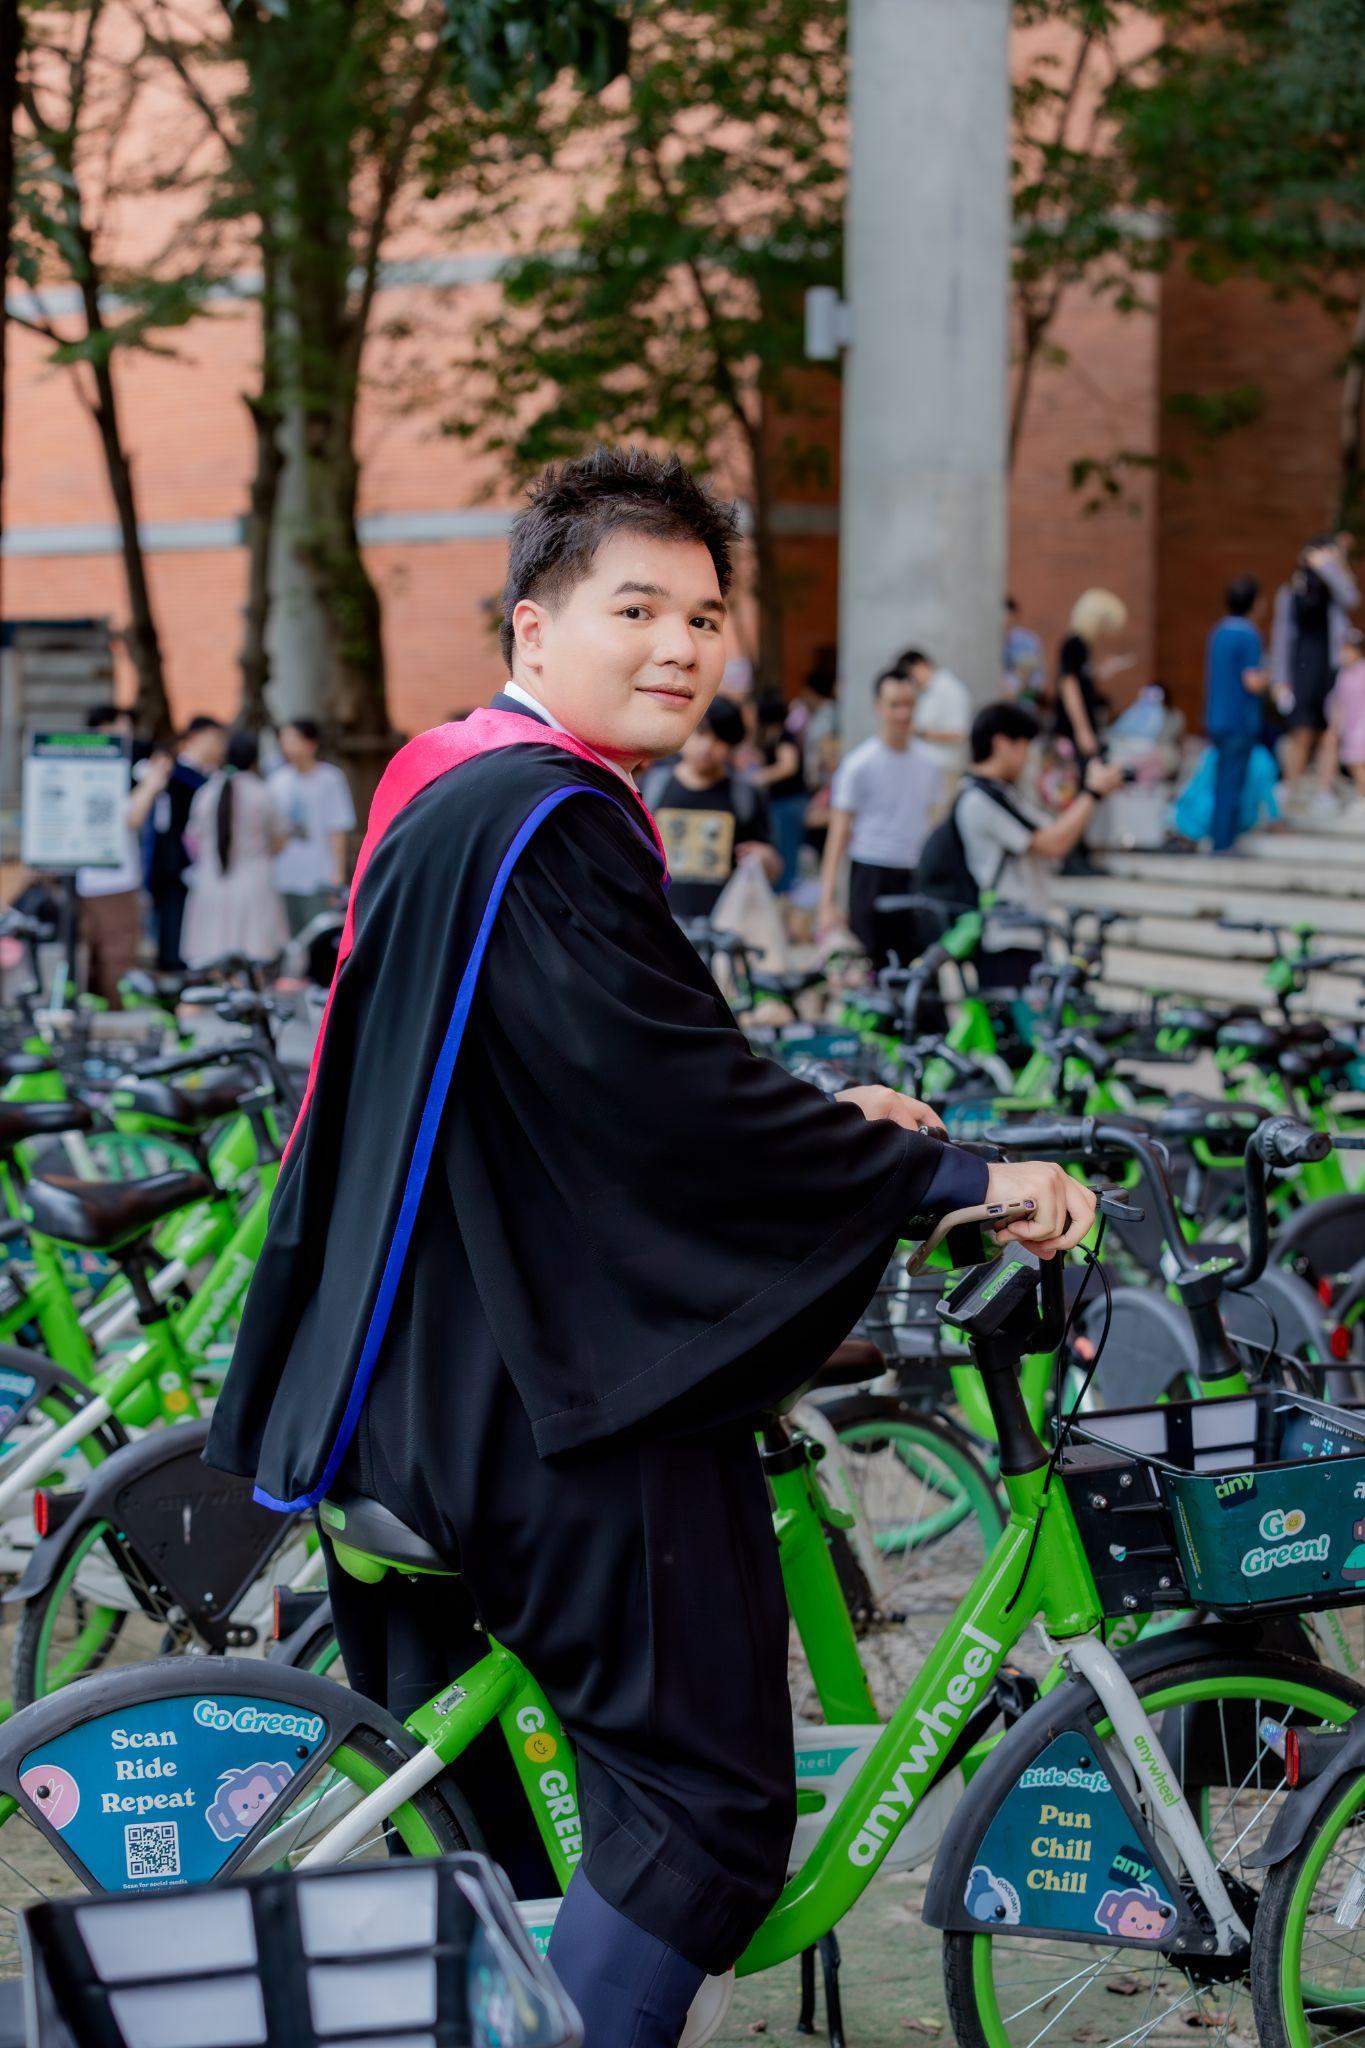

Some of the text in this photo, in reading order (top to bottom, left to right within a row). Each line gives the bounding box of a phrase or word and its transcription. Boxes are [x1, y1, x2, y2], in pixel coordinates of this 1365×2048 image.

[1214, 1472, 1255, 1500] any
[1243, 1536, 1329, 1575] Green!
[194, 1701, 322, 1741] Go Green!
[111, 1729, 178, 1750] Scan
[848, 1622, 1002, 1867] anywheel
[115, 1757, 178, 1780] Ride
[797, 1752, 832, 1770] heel
[1133, 1734, 1181, 1808] anywheel
[1021, 1768, 1111, 1792] Ride Safe
[101, 1788, 196, 1815] Repeat
[1039, 1805, 1092, 1829] Pun
[1031, 1837, 1091, 1861] Chill
[1027, 1869, 1088, 1894] Chill
[1112, 1855, 1153, 1882] any
